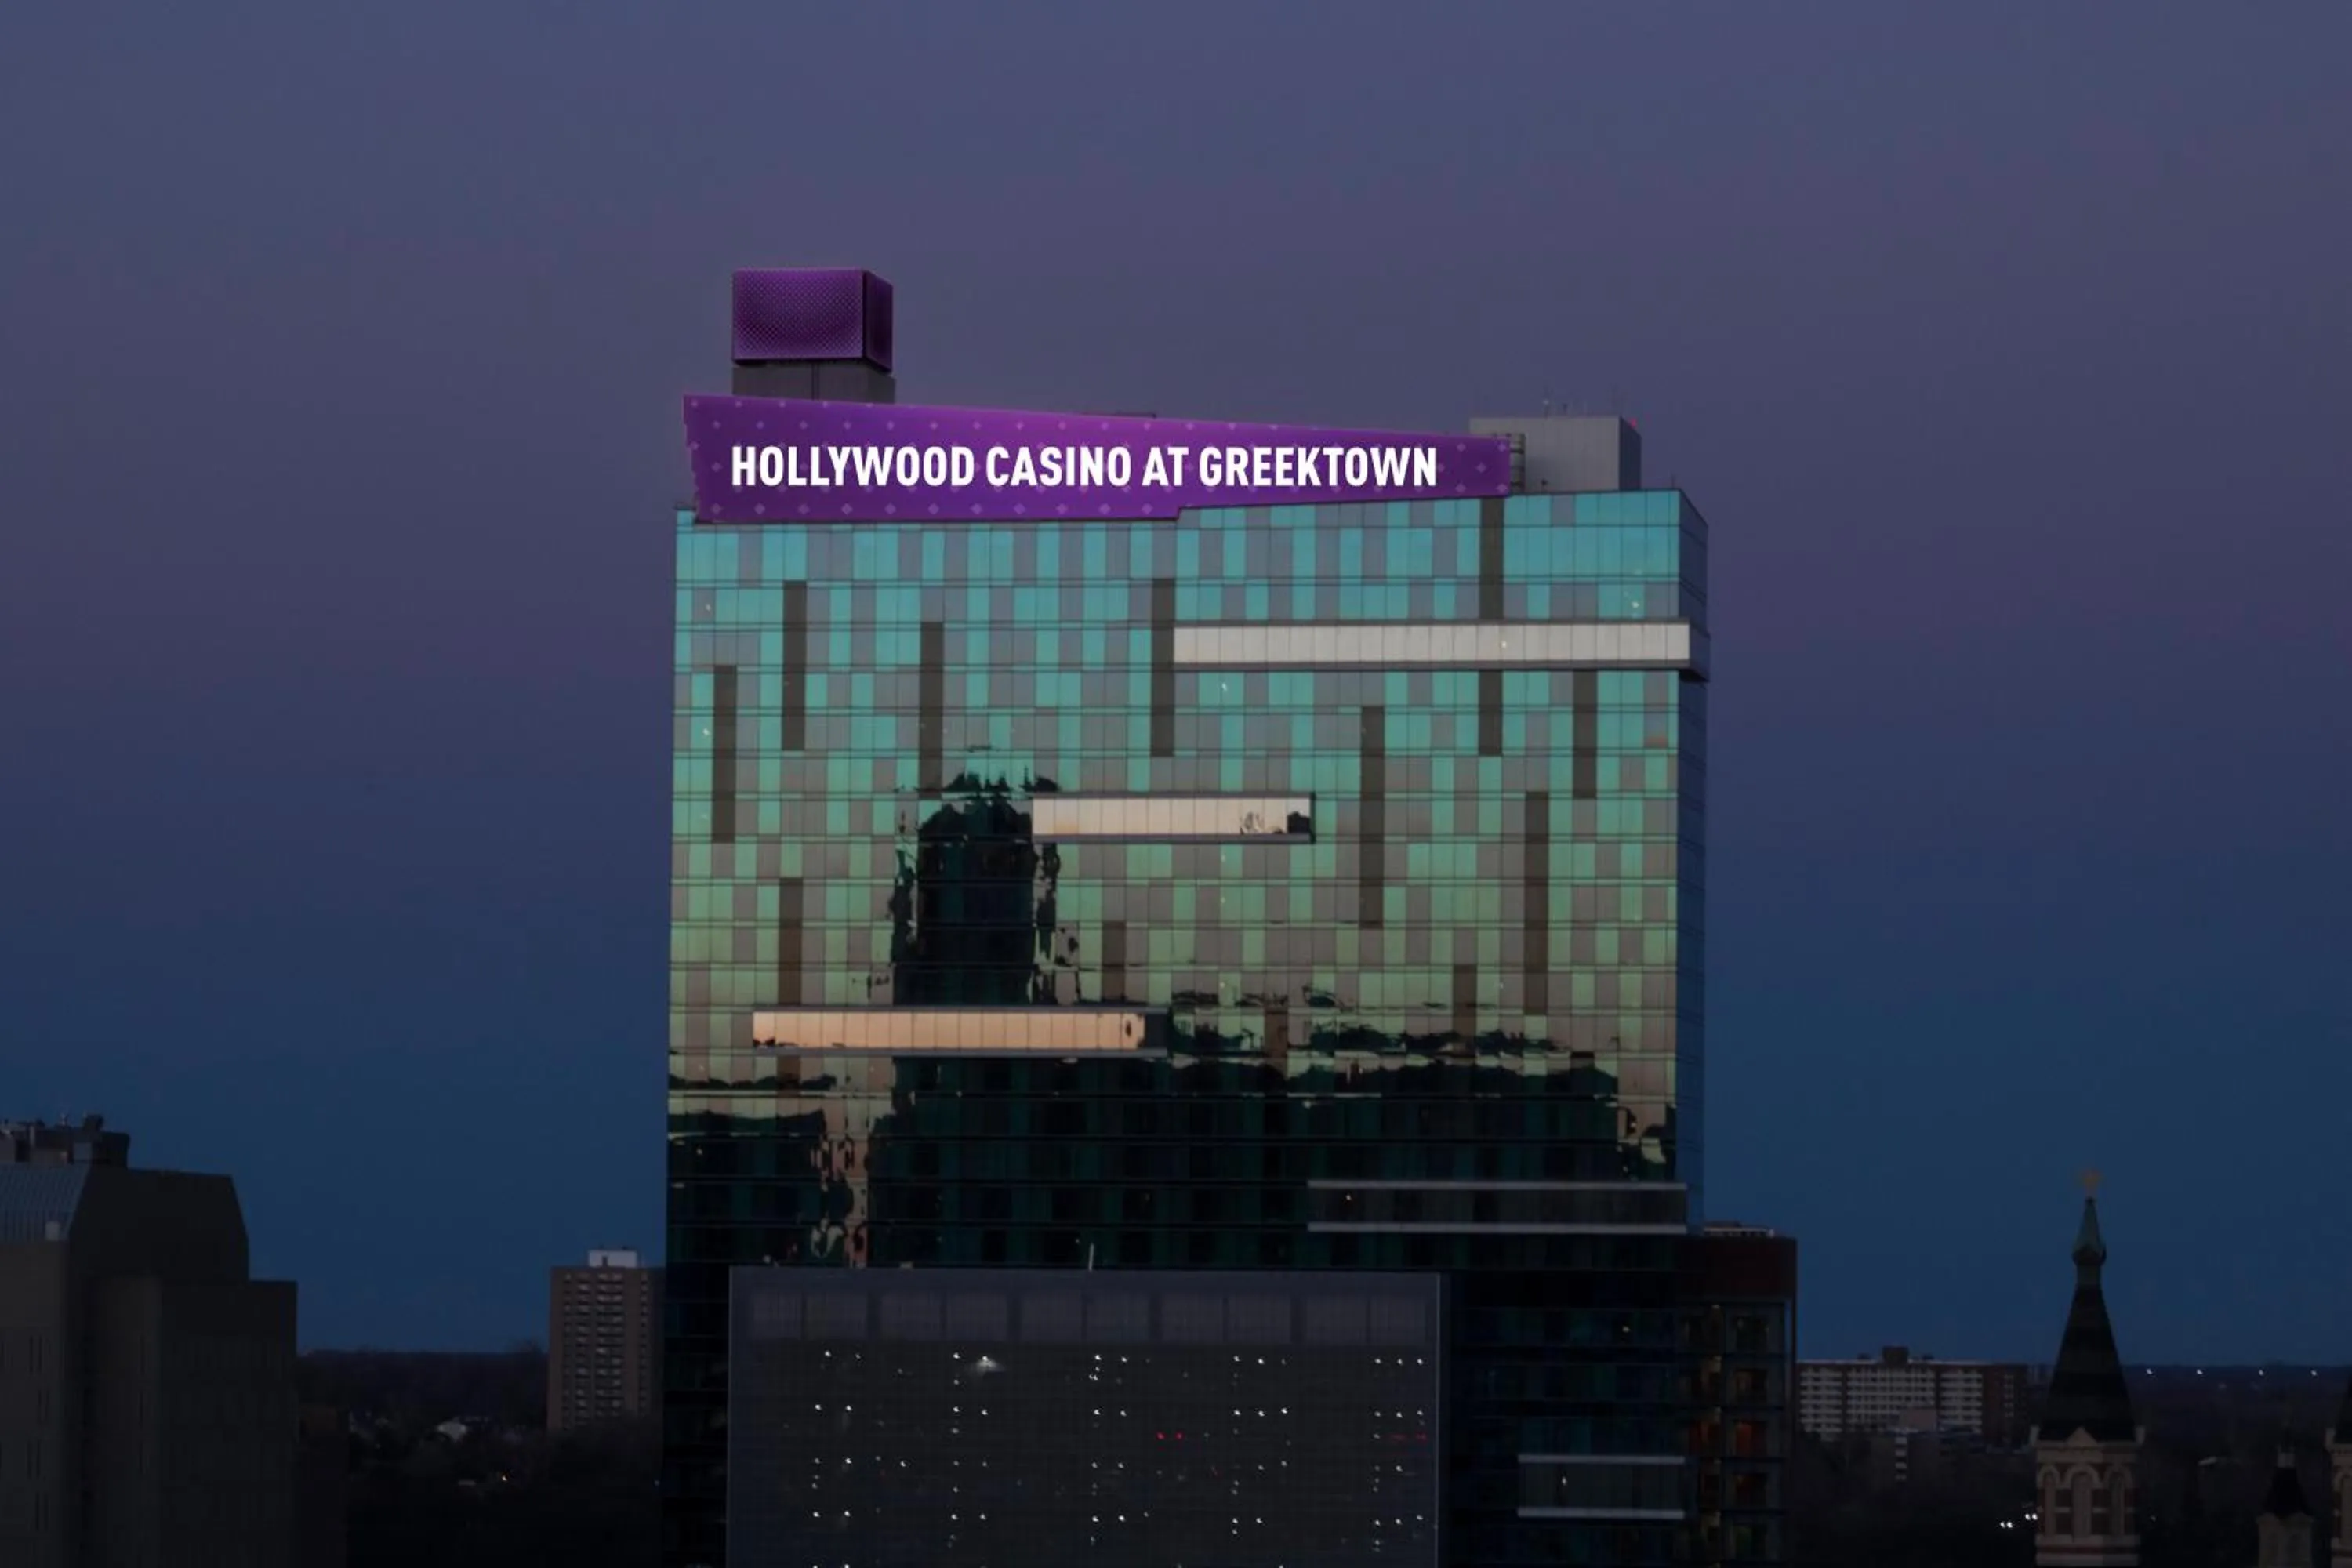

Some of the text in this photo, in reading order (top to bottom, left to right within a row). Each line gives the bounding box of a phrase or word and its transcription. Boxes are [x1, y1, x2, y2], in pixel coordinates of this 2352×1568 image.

[731, 445, 1437, 487] HOLLYWOOD CASINO AT GREEKTOWN
